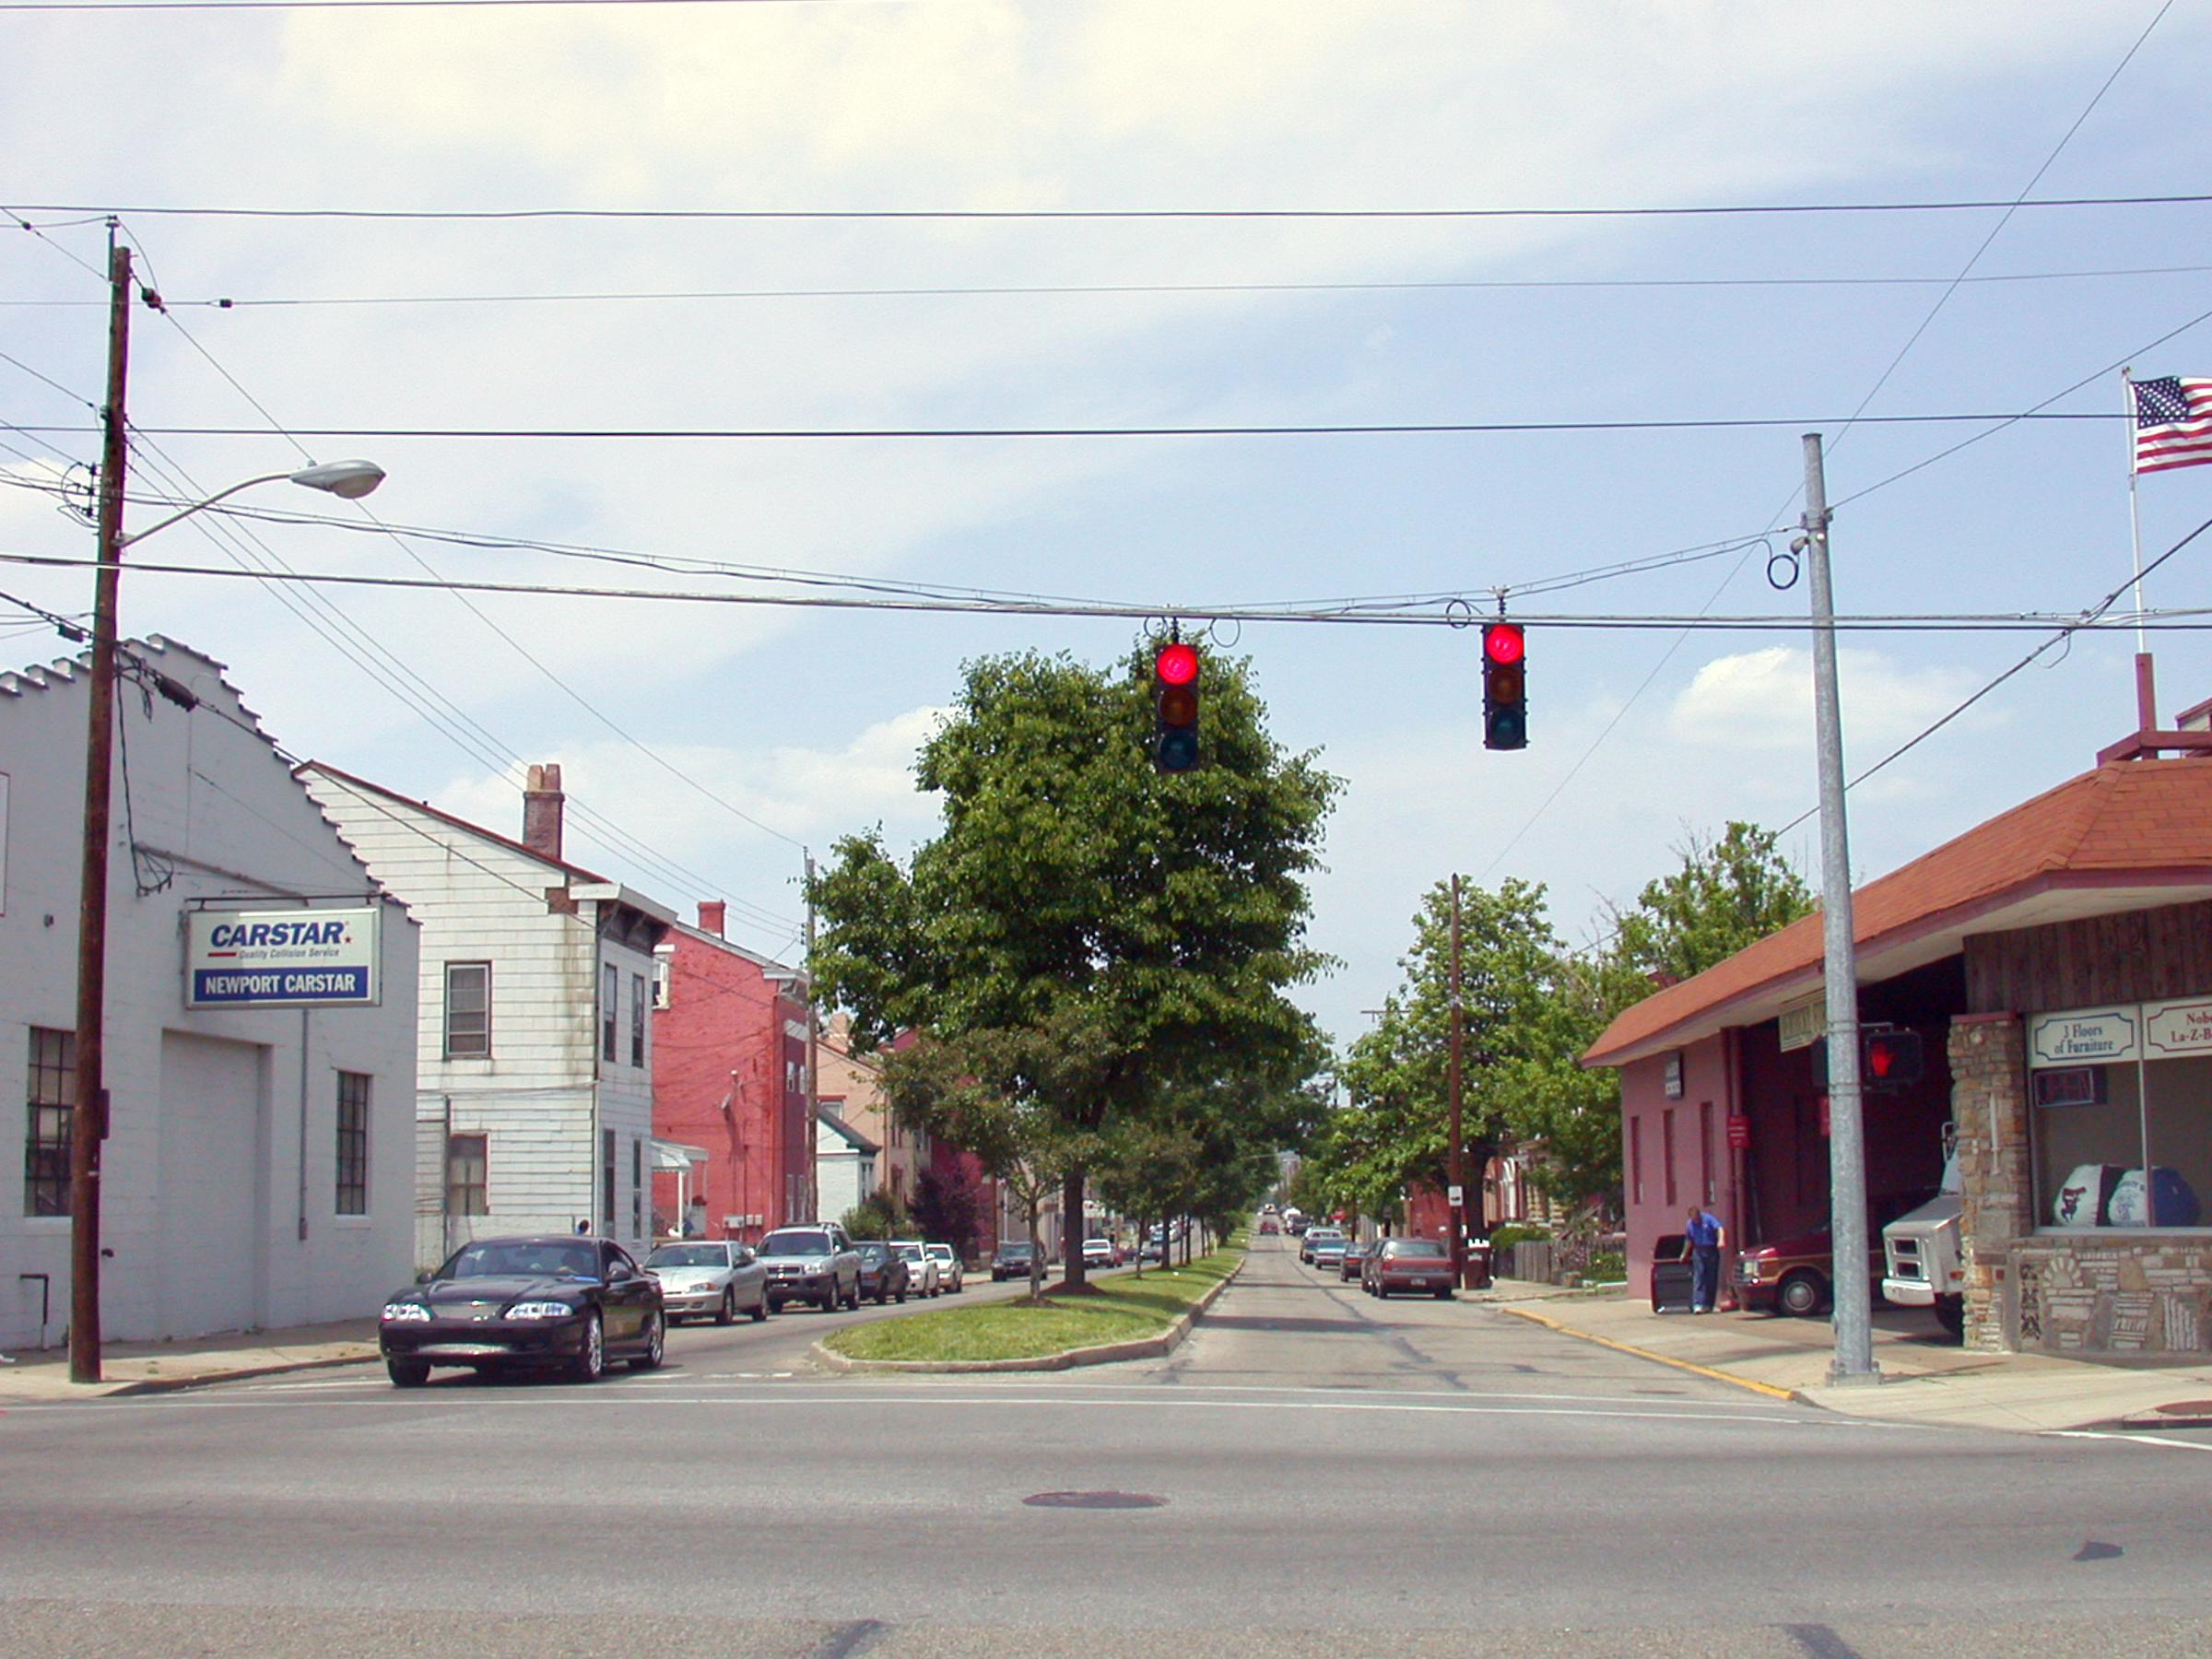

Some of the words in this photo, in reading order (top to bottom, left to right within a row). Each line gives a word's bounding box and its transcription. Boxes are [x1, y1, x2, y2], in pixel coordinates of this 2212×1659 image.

[211, 922, 345, 947] CARSTAR
[239, 949, 267, 959] Quality
[270, 948, 306, 958] Collision
[309, 947, 339, 957] Service
[206, 975, 280, 994] NEWPORT
[285, 973, 356, 993] CARSTAR
[2064, 1025, 2070, 1039] 3
[2073, 1023, 2103, 1038] Floors
[2171, 1027, 2212, 1042] La-Z-B
[2054, 1040, 2065, 1054] of
[2067, 1039, 2113, 1053] Furniture
